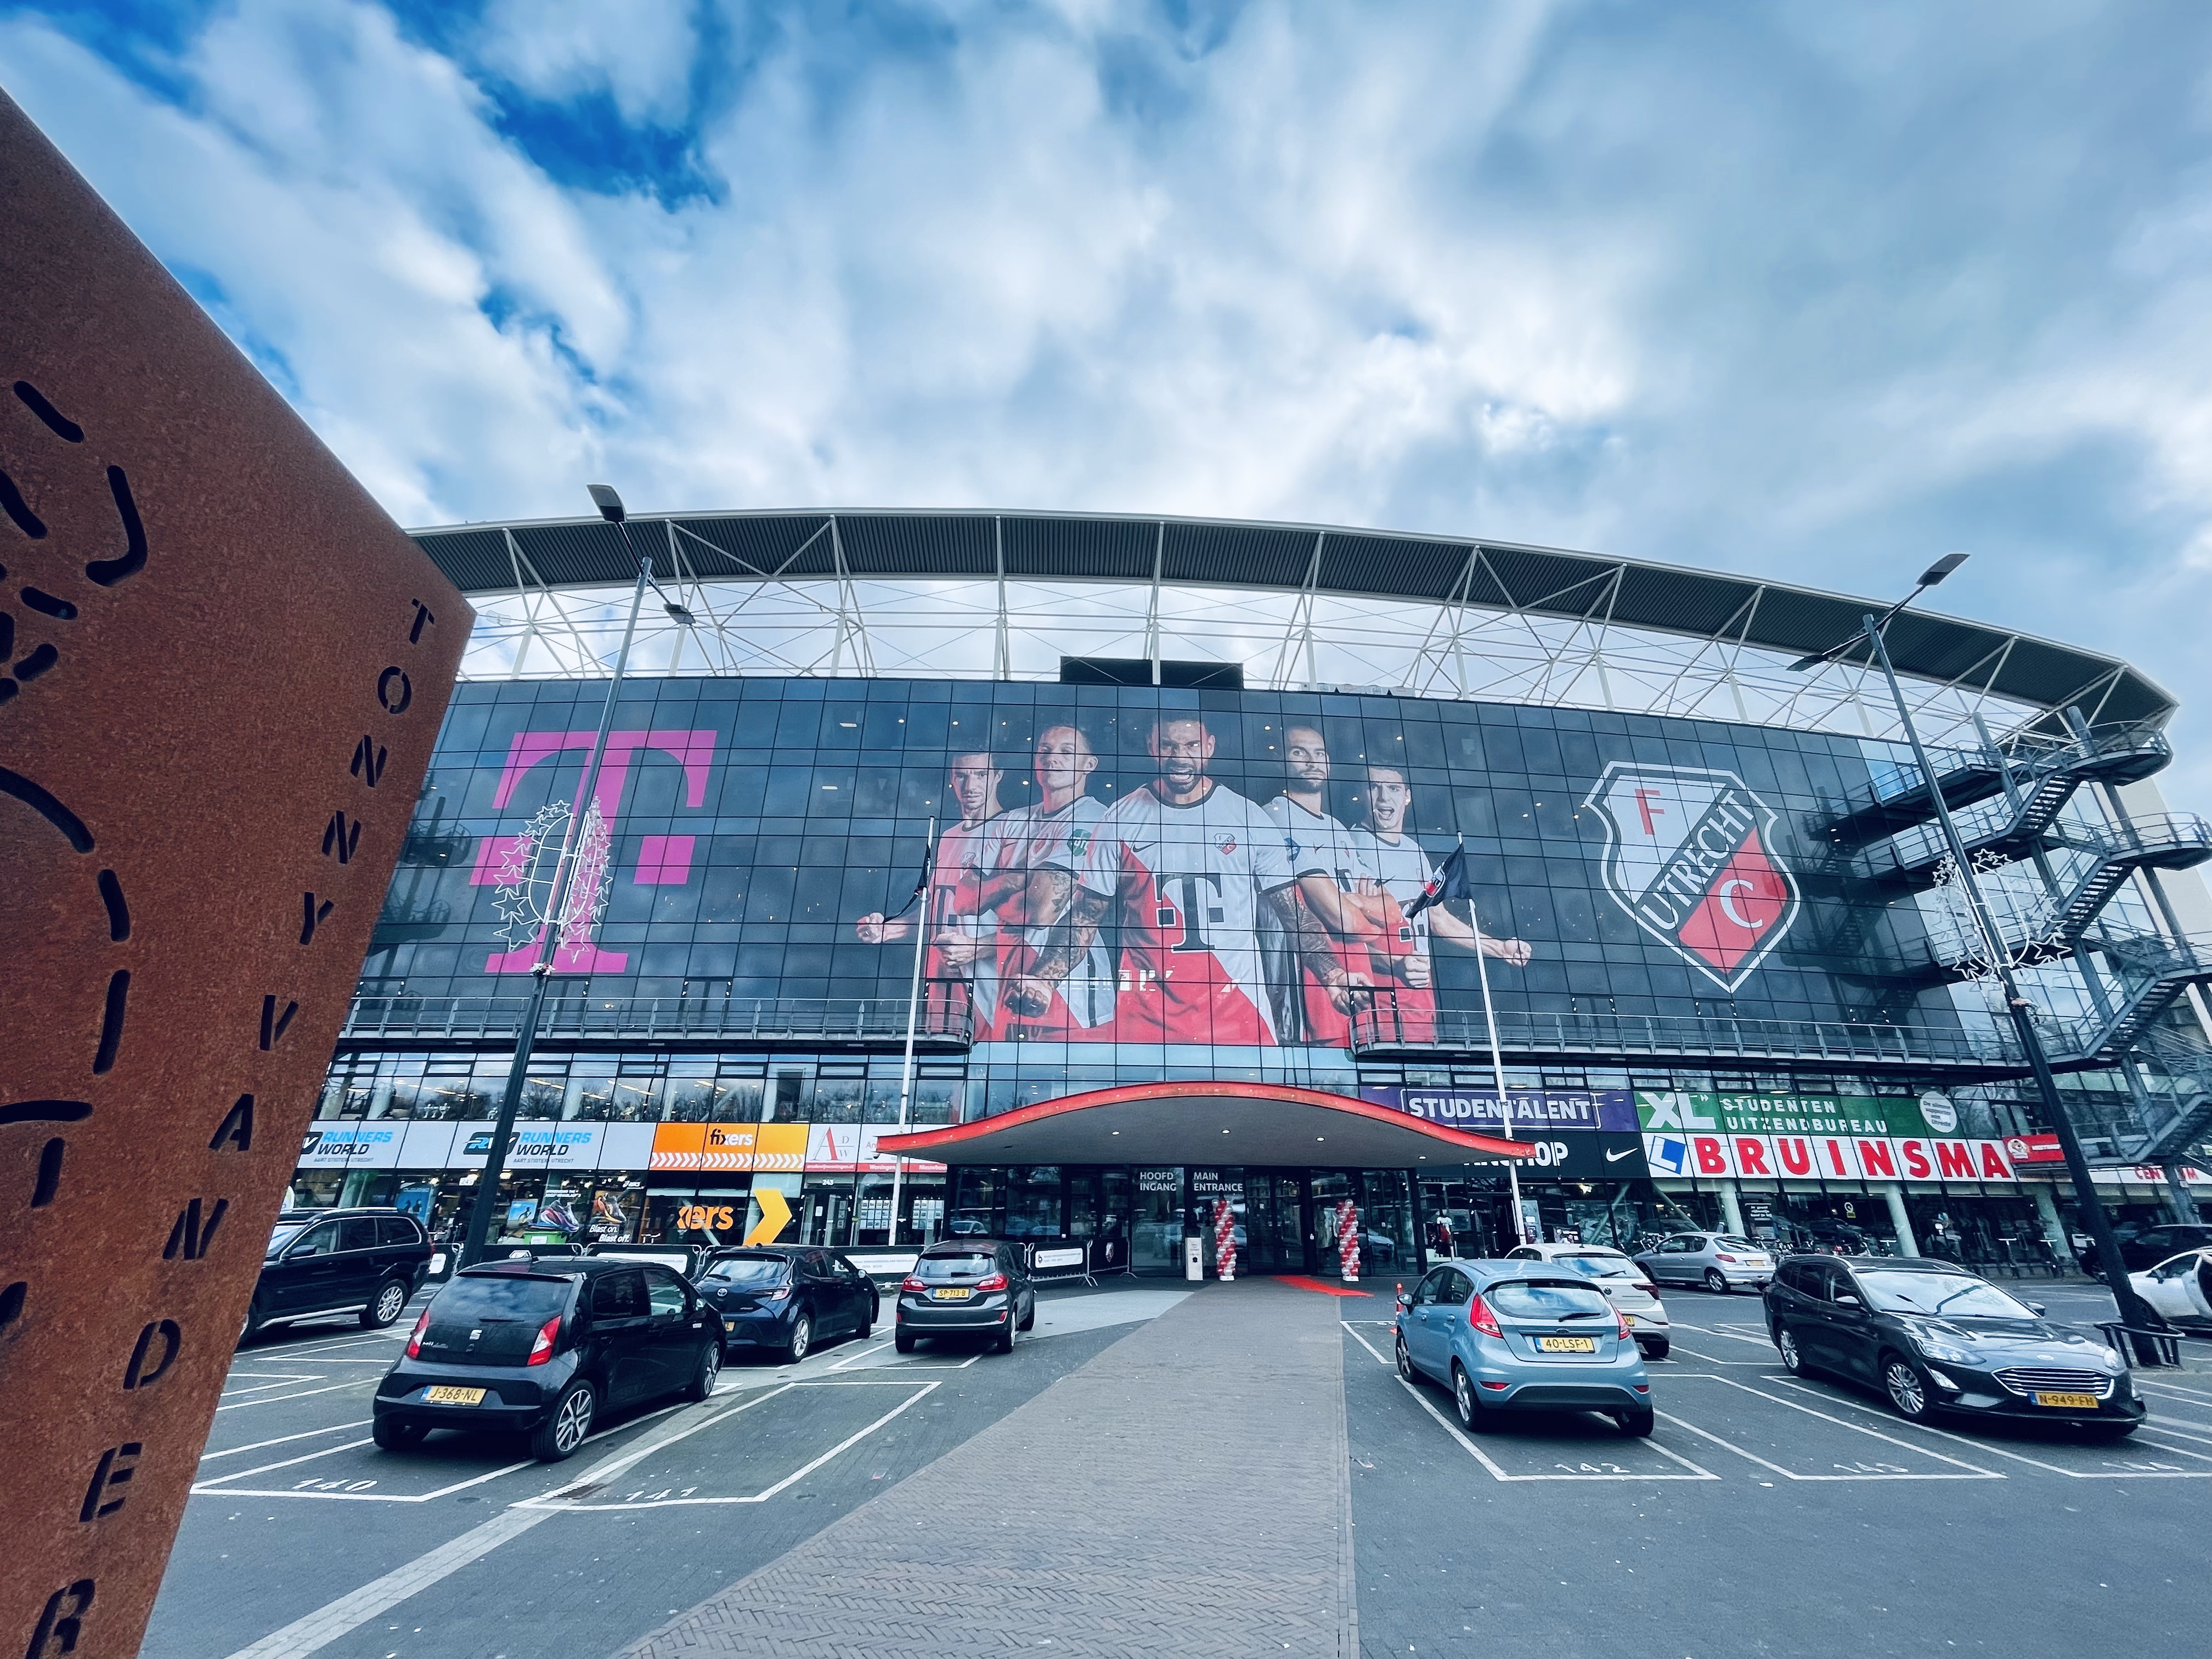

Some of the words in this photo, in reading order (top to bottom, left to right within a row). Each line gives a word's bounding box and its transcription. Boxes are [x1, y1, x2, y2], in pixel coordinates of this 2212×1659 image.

[300, 598, 435, 945] TONNY
[1634, 788, 1665, 836] F
[1640, 789, 1754, 930] UTRECHT
[1719, 879, 1764, 929] C
[1639, 1092, 1716, 1130] XL
[1723, 1098, 1837, 1114] STUDENTEN
[162, 994, 299, 1260] VAN
[1726, 1116, 1888, 1133] UITZENDBUREAU
[321, 1131, 394, 1143] RUNNERS
[520, 1131, 592, 1144] RUNNERS
[710, 1128, 753, 1146] fixers
[317, 1143, 370, 1155] WORLD
[516, 1144, 569, 1156] WORLD
[1693, 1137, 2012, 1179] BRUINSMA
[1139, 1172, 1173, 1180] HOOFD
[1193, 1172, 1218, 1180] MAIN
[1139, 1183, 1177, 1191] INGANG
[1193, 1183, 1243, 1192] ENTRANCE
[589, 1224, 607, 1233] Blast
[598, 1234, 617, 1243] Blast
[1545, 1339, 1589, 1348] 40-LSF-1
[430, 1387, 478, 1401] J-368-NL
[2039, 1395, 2094, 1406] N-949-FH
[1554, 1462, 1631, 1474] 142
[26, 1319, 182, 1659] DER
[291, 1477, 378, 1492] 140
